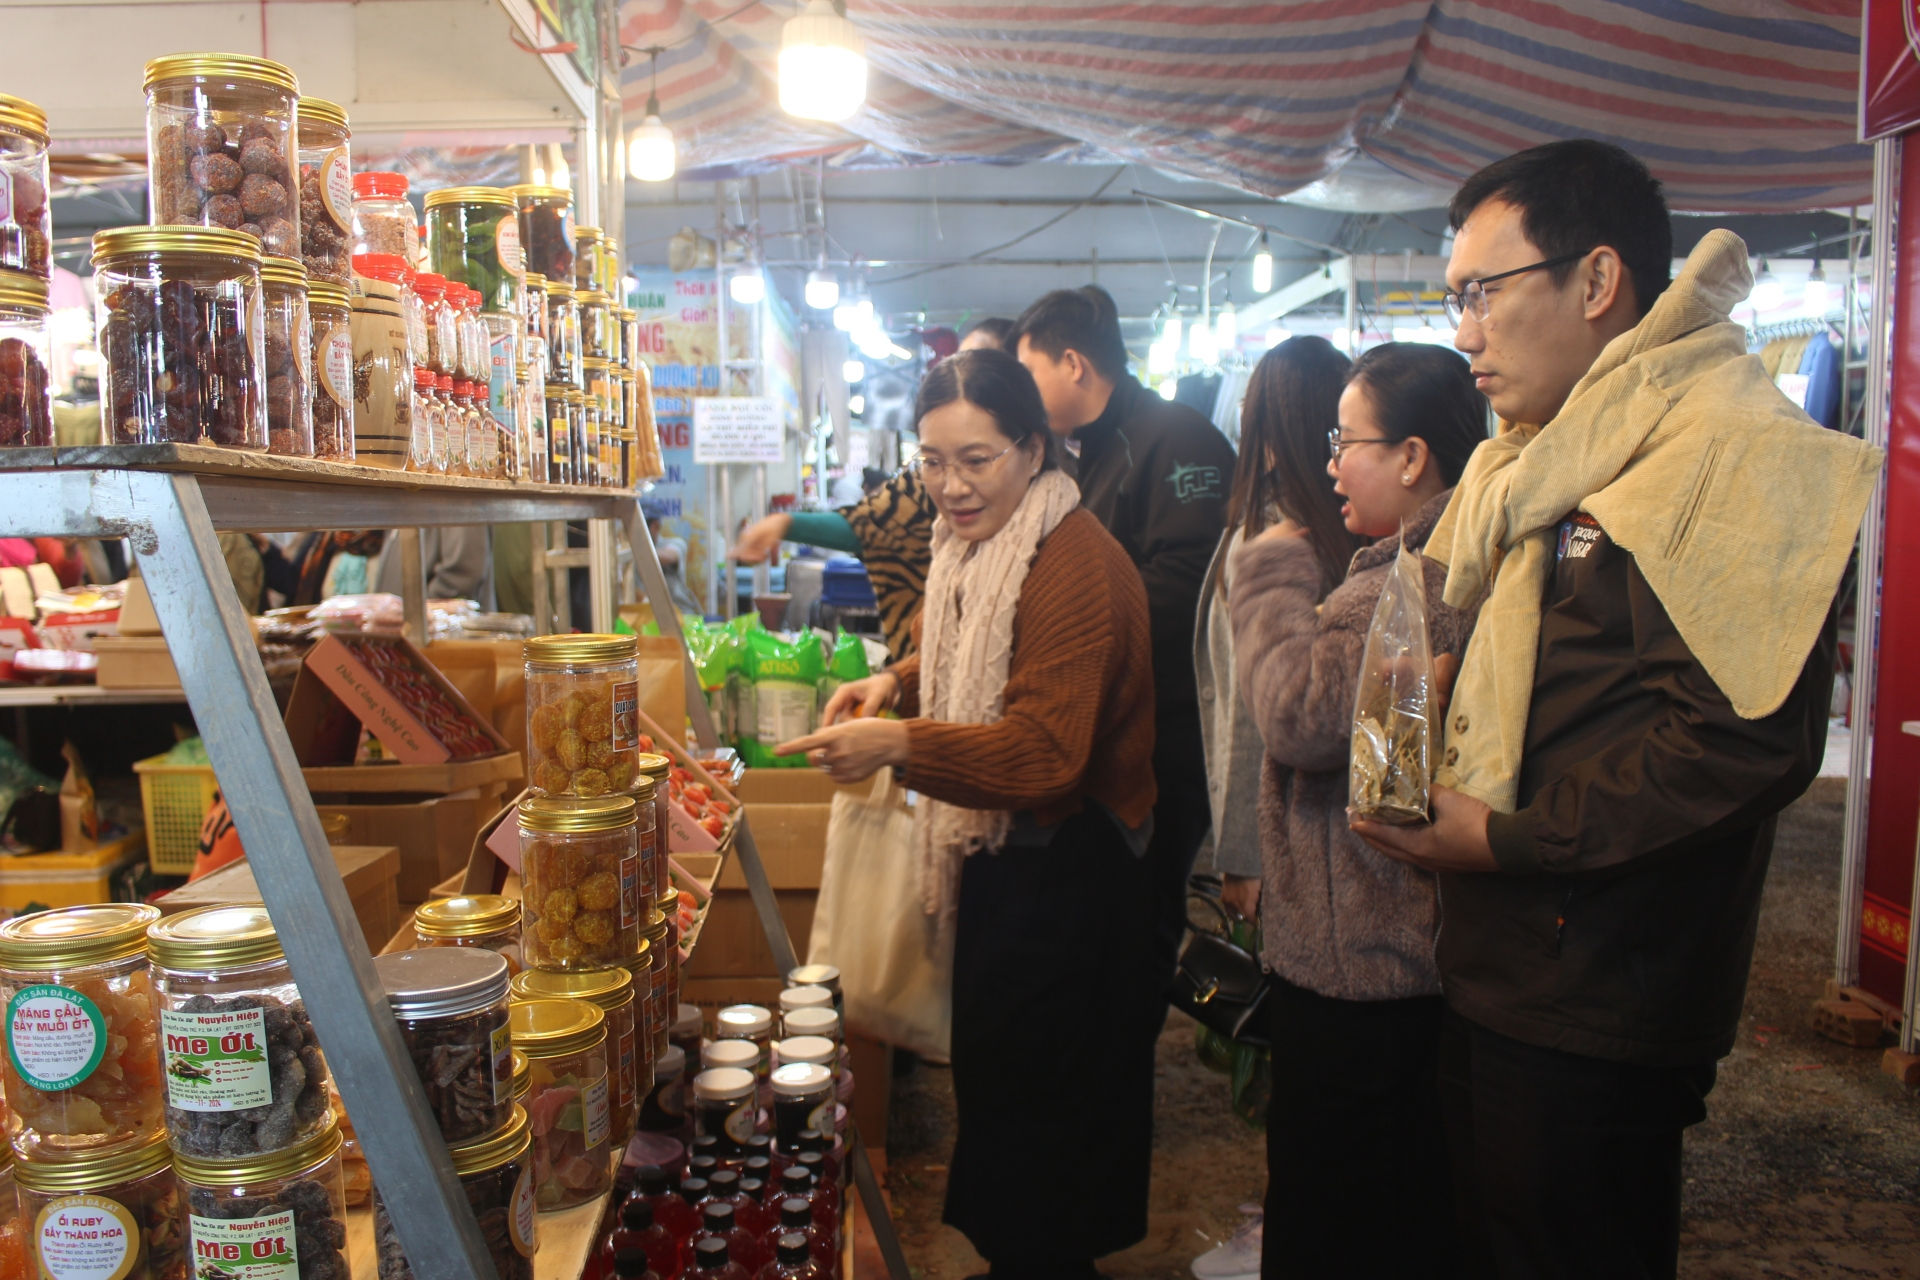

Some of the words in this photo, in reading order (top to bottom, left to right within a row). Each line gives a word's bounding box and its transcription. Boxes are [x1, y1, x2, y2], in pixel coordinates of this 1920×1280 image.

[638, 322, 665, 353] NG
[657, 421, 690, 449] NG
[237, 1012, 259, 1022] Hiệp
[72, 1217, 104, 1226] RUBY
[268, 1216, 290, 1226] Hiệp
[101, 1228, 123, 1239] HOA
